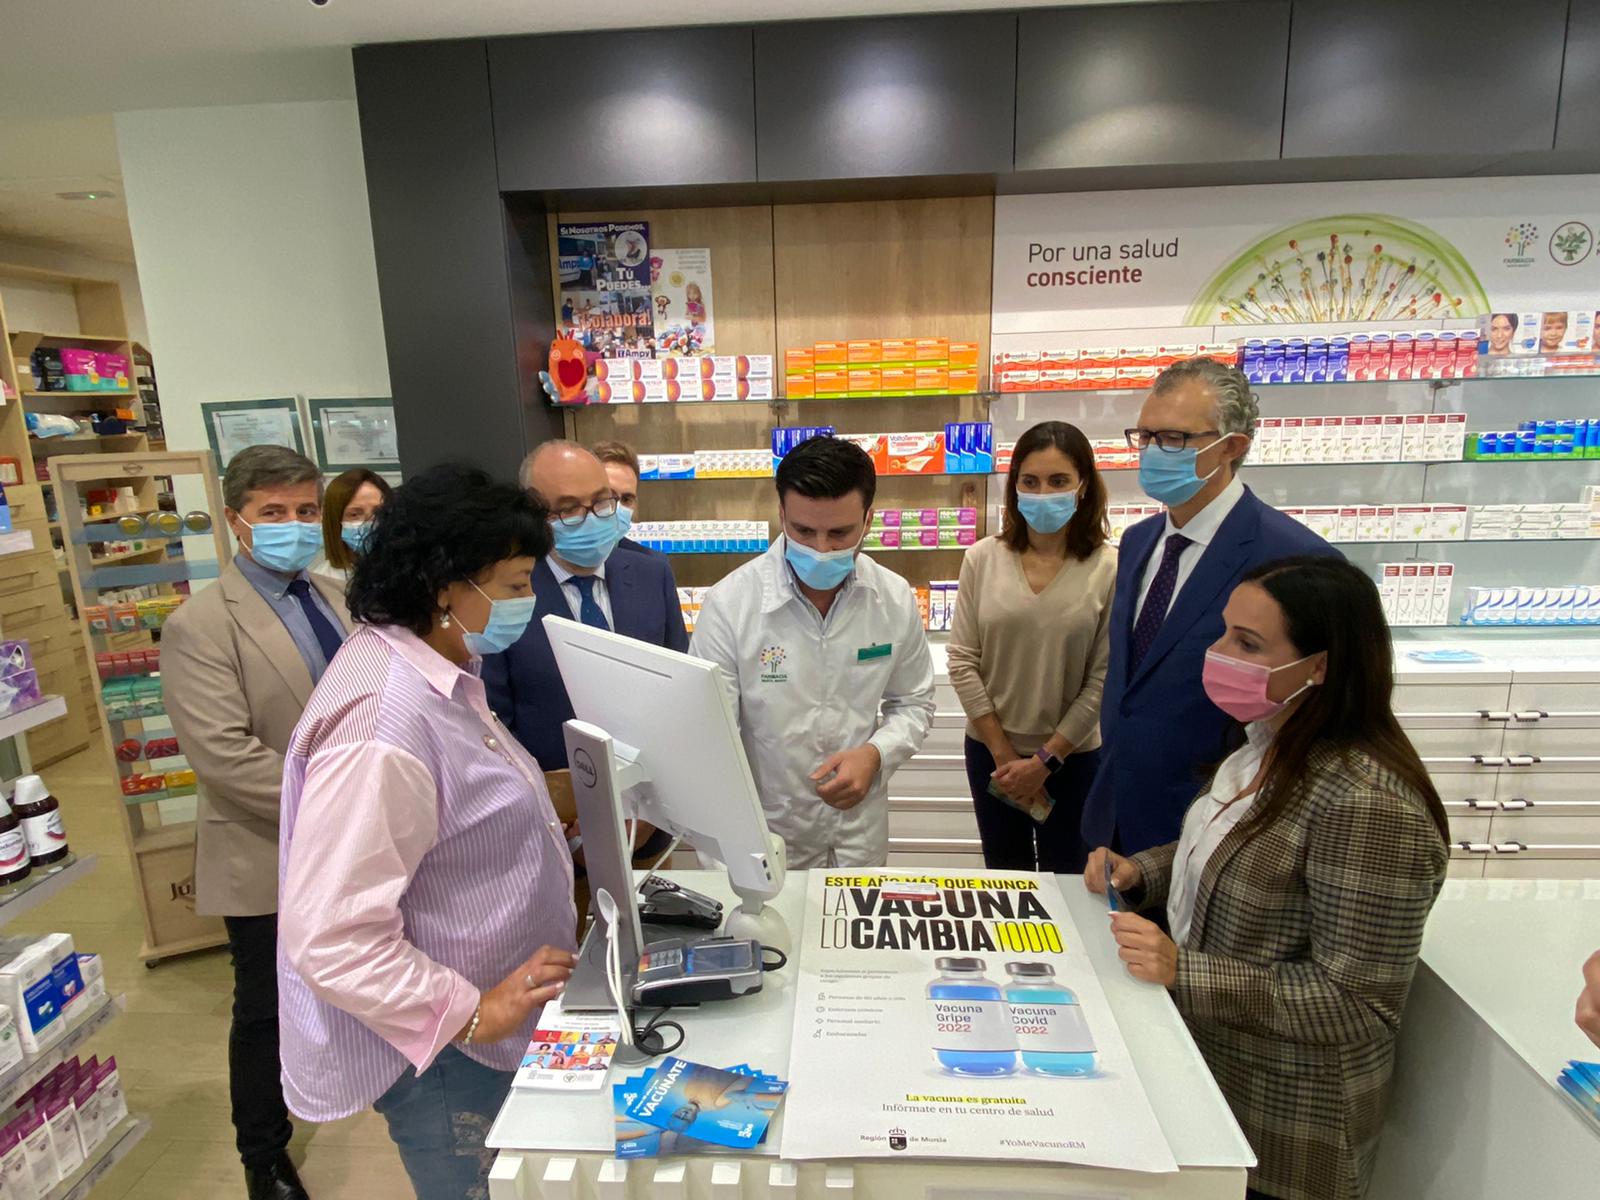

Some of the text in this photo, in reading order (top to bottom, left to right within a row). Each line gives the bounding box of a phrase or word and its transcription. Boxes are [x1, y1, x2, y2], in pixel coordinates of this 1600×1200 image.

[1028, 237, 1179, 263] Por una salud
[1027, 265, 1142, 287] consciente
[625, 349, 651, 358] Ampy
[826, 876, 862, 887] ESTE
[944, 878, 976, 889] QUE
[981, 879, 1039, 891] NUNCA
[849, 888, 1053, 920] VACUNA
[821, 917, 1064, 954] LO CAMBIA TODO
[935, 1003, 983, 1014] Vacuna
[1009, 1005, 1057, 1016] Vacuna
[936, 1013, 972, 1024] Gripe
[1010, 1014, 1048, 1025] Covid
[938, 1022, 972, 1033] 2022
[1015, 1024, 1049, 1035] 2022
[638, 1060, 688, 1117] VACÚNATE
[906, 1093, 1027, 1106] La vacuna es gratuita
[882, 1103, 1055, 1118] Infórmate en tu centro de salud
[860, 1135, 887, 1143] Región
[999, 1138, 1087, 1150] #YoMeVacunoRM
